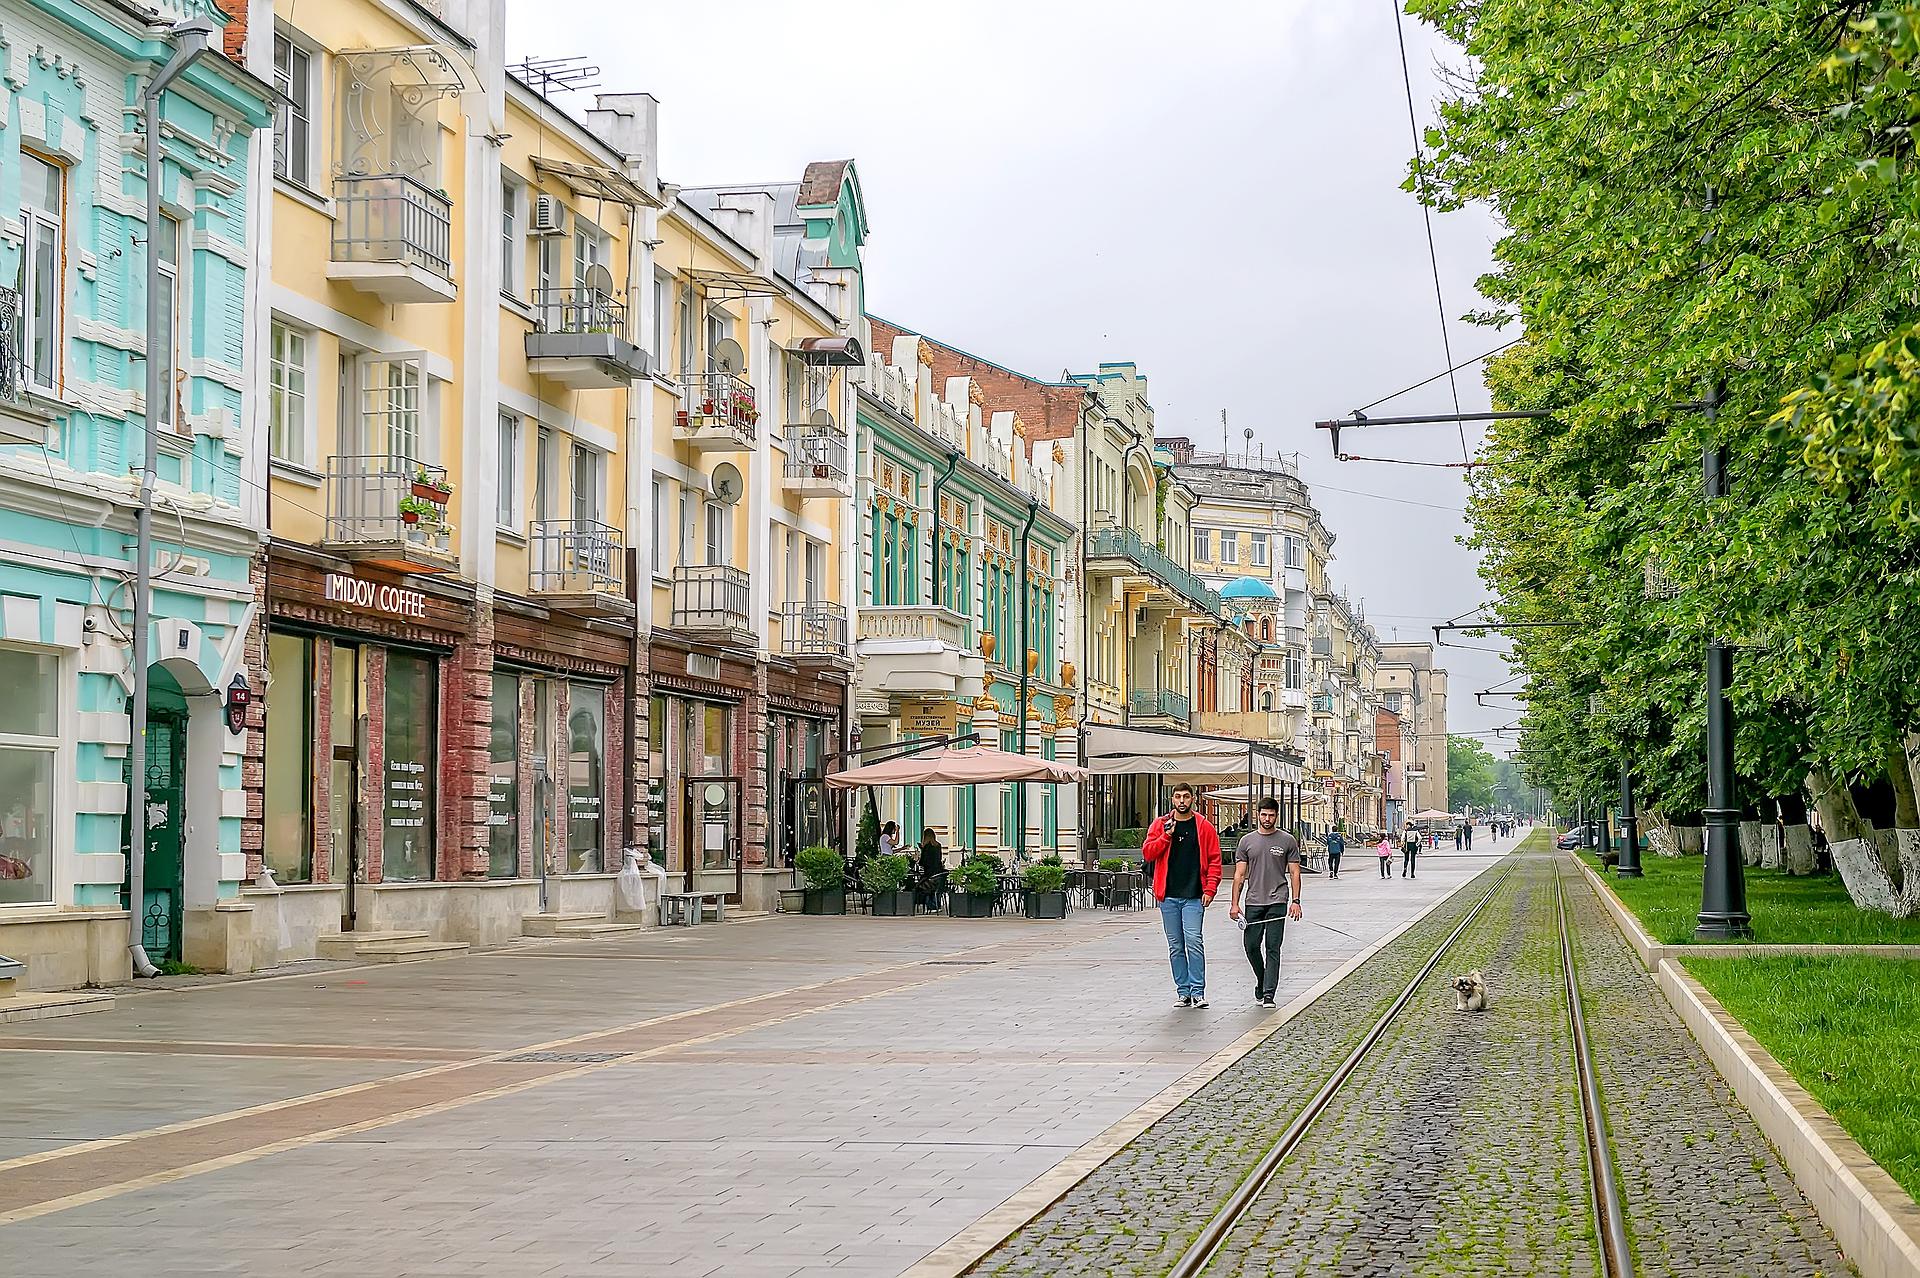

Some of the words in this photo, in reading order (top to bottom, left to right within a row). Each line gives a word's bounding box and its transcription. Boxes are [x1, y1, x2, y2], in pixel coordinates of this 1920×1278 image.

[326, 573, 376, 608] MIDOV
[380, 585, 426, 618] COFFEE
[236, 692, 246, 700] 14
